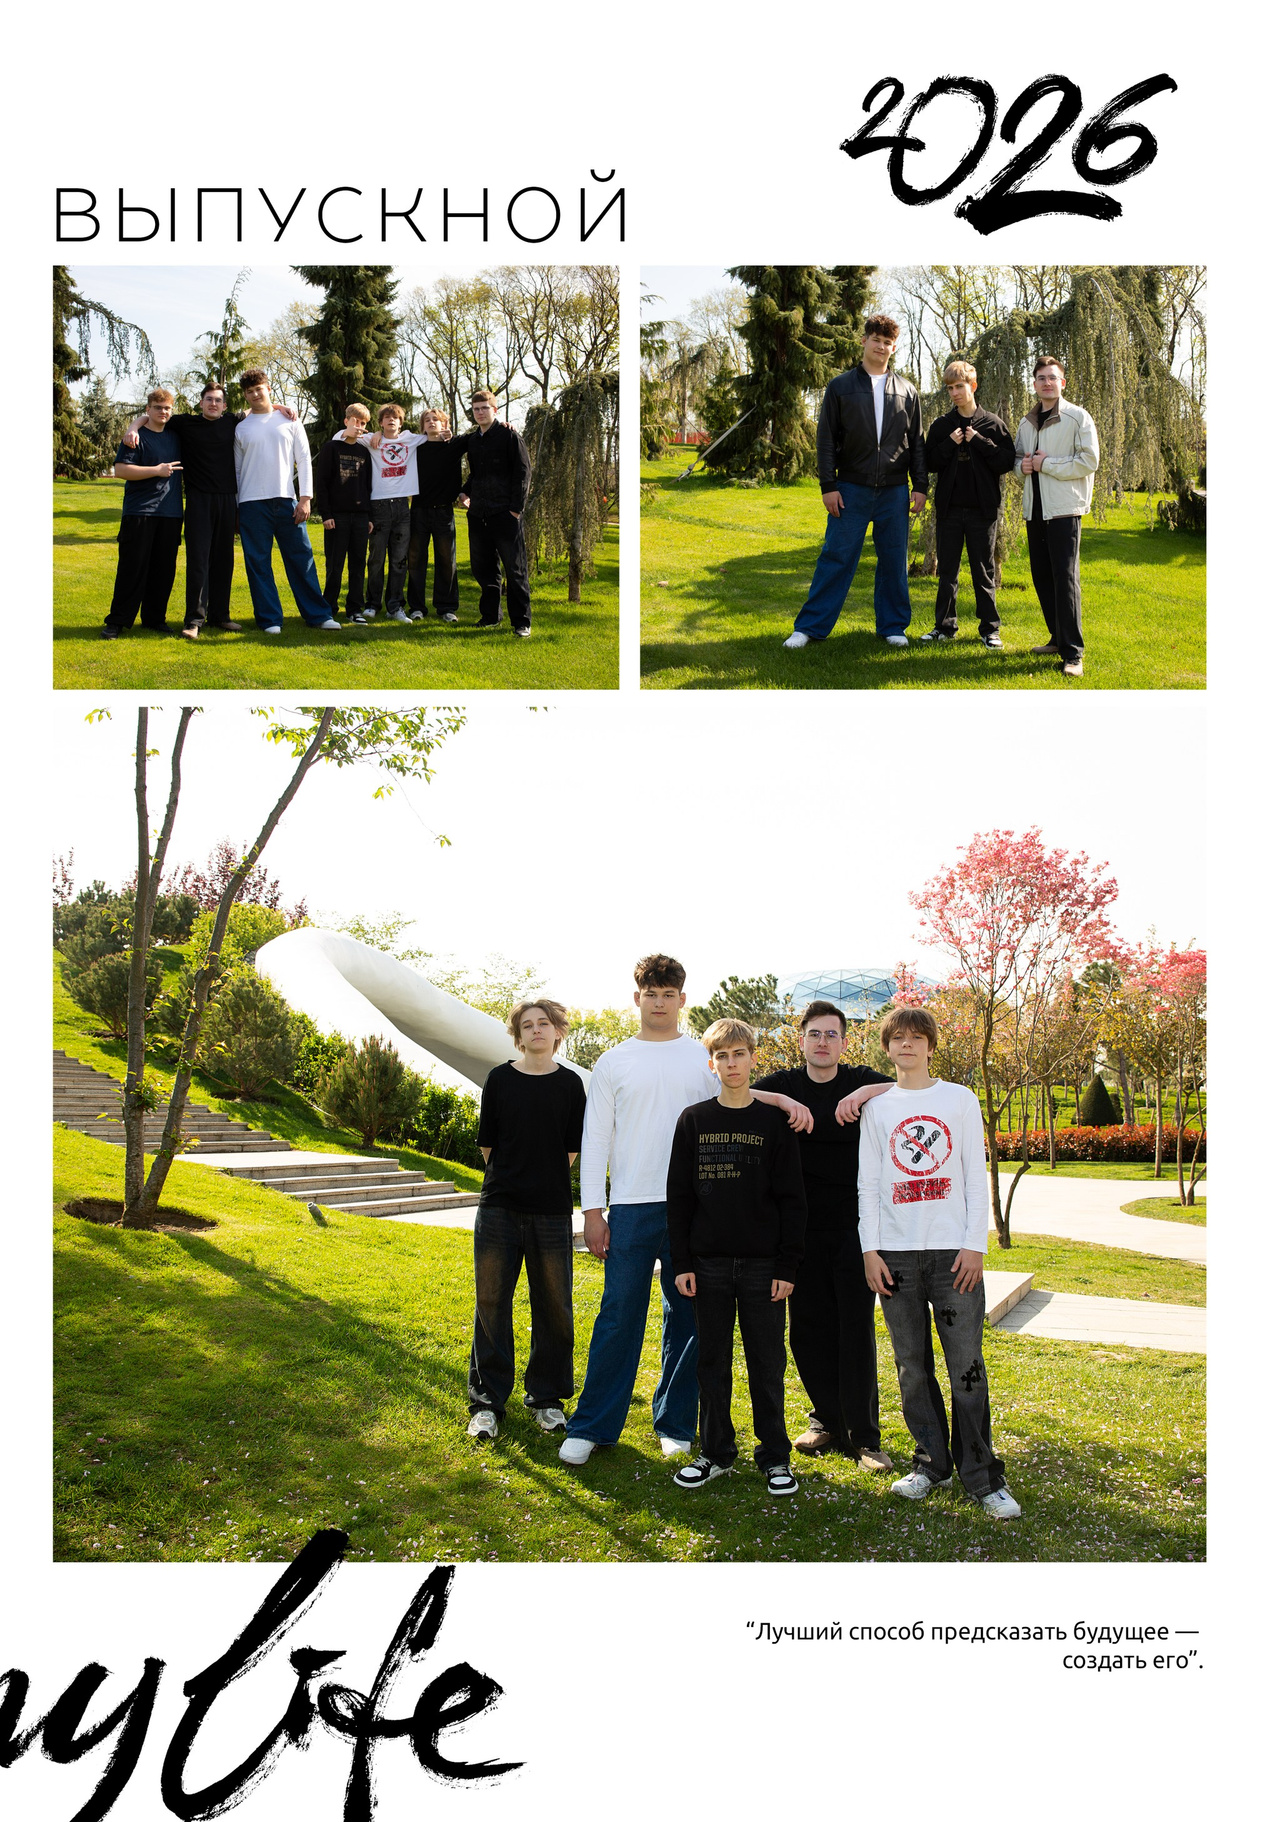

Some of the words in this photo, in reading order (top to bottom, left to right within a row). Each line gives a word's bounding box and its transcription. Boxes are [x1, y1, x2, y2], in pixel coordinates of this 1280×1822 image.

[699, 1133, 730, 1144] HYBRID
[731, 1133, 764, 1146] PROJECT
[699, 1144, 725, 1153] SERVICE
[699, 1154, 737, 1163] FUNCTIONAL
